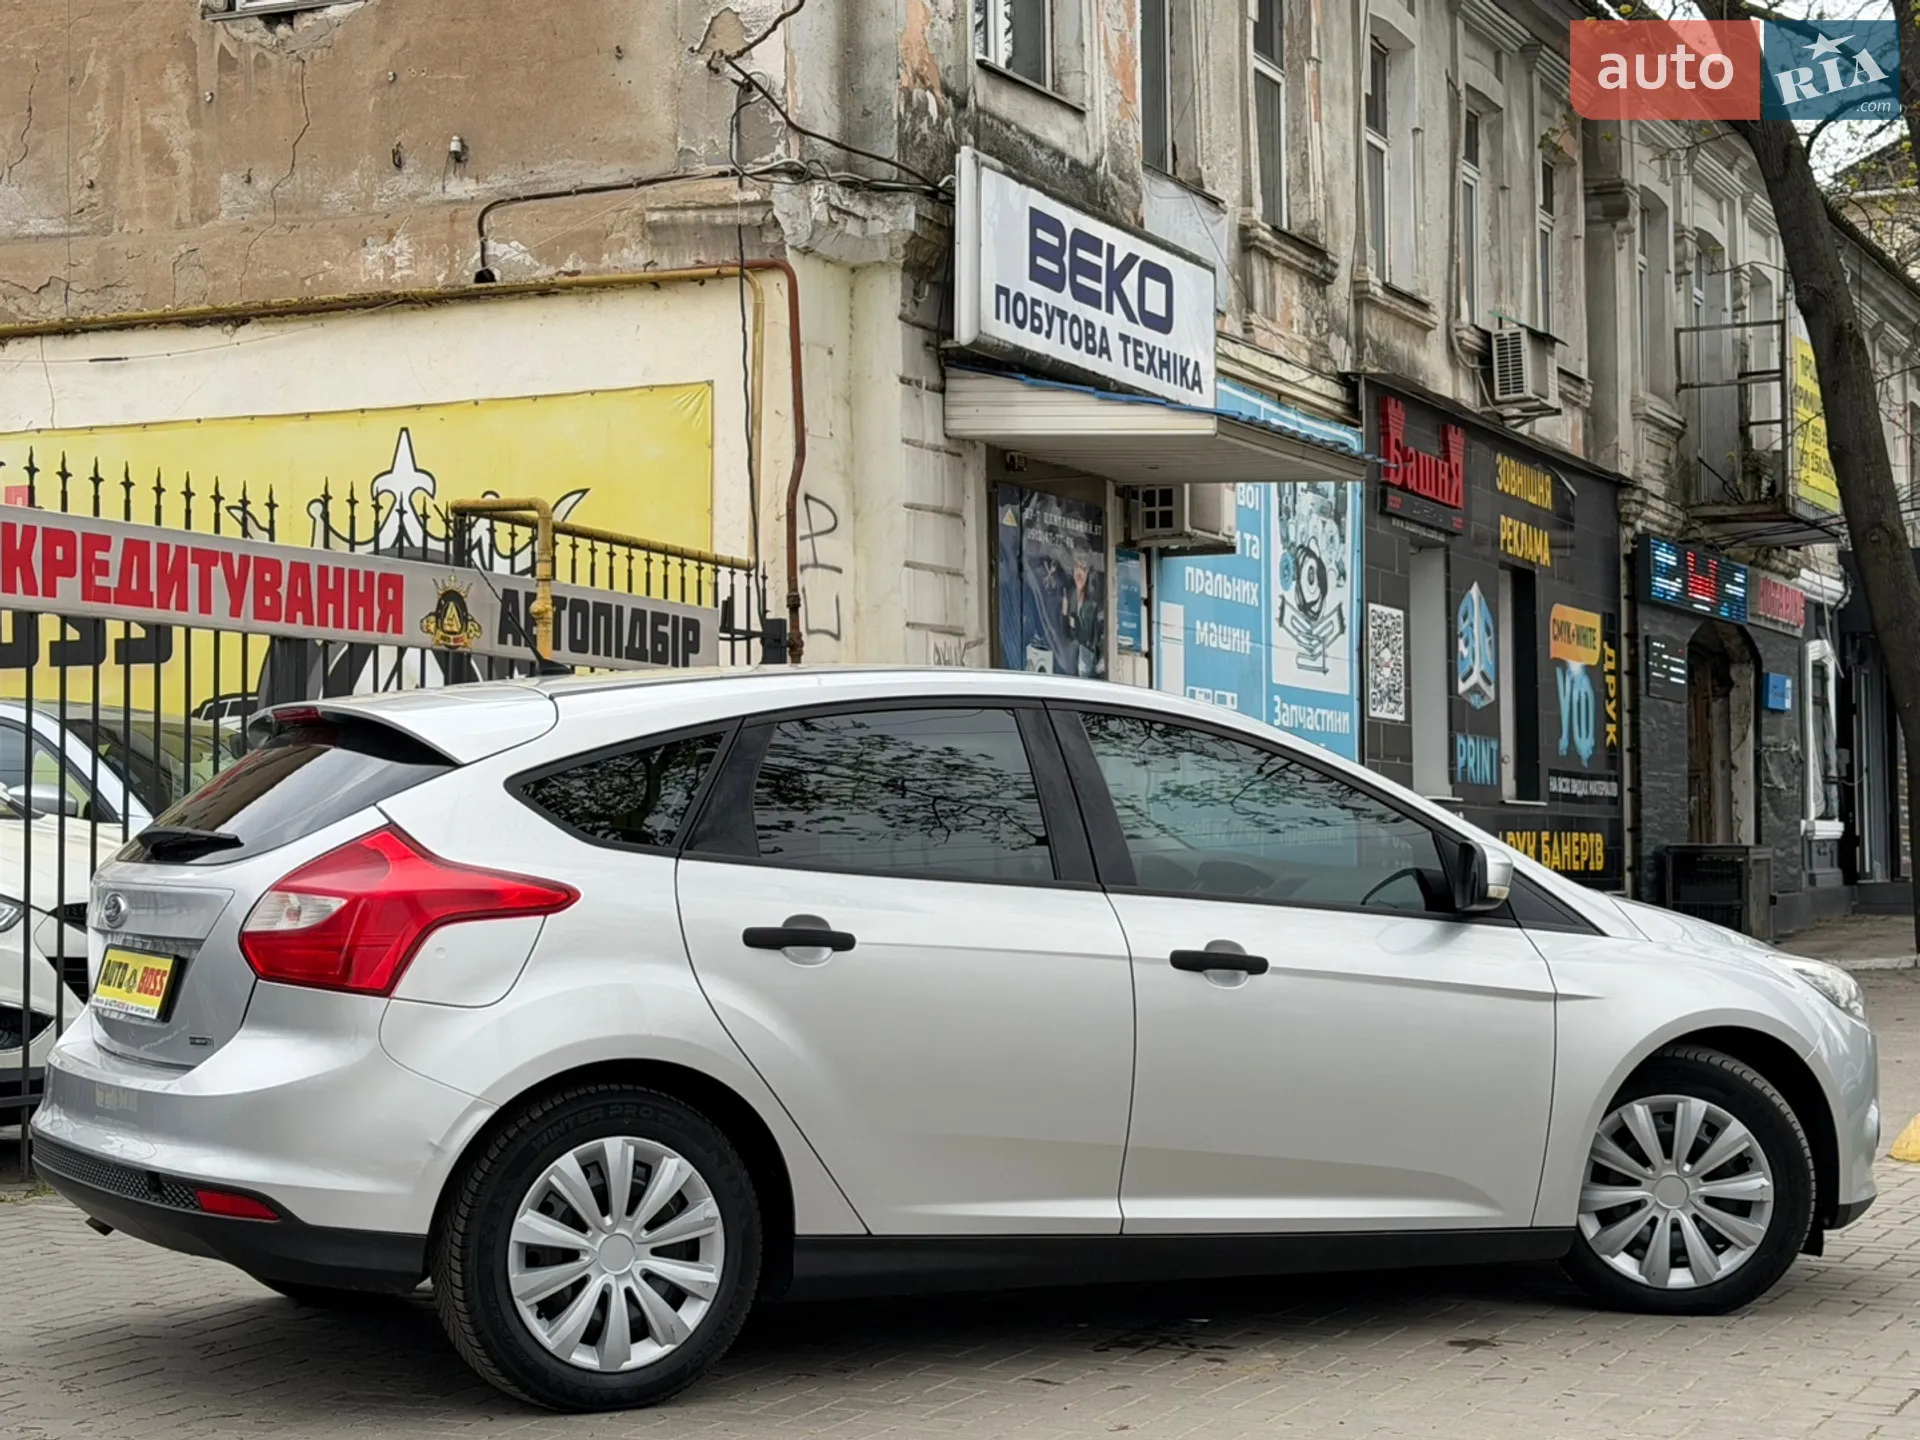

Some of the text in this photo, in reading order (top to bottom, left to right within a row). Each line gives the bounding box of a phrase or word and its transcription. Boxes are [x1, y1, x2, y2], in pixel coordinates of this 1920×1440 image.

[1028, 205, 1174, 336] BEKO
[995, 283, 1203, 394] ПОБУТОВА ТЕХНІКА
[1495, 452, 1552, 510] ЗОВНІШНЯ
[1500, 514, 1550, 568] РЕКЛАМА
[1, 521, 405, 635] КРЕДИТУВАННЯ
[1185, 565, 1259, 607] пральних
[1195, 619, 1251, 655] машин
[1272, 694, 1350, 735] Запчастини
[1603, 641, 1617, 748] ДРУК
[1456, 733, 1499, 786] PRINT
[1540, 831, 1605, 871] БАНЕРІВ
[100, 959, 169, 998] AUTO BOSS
